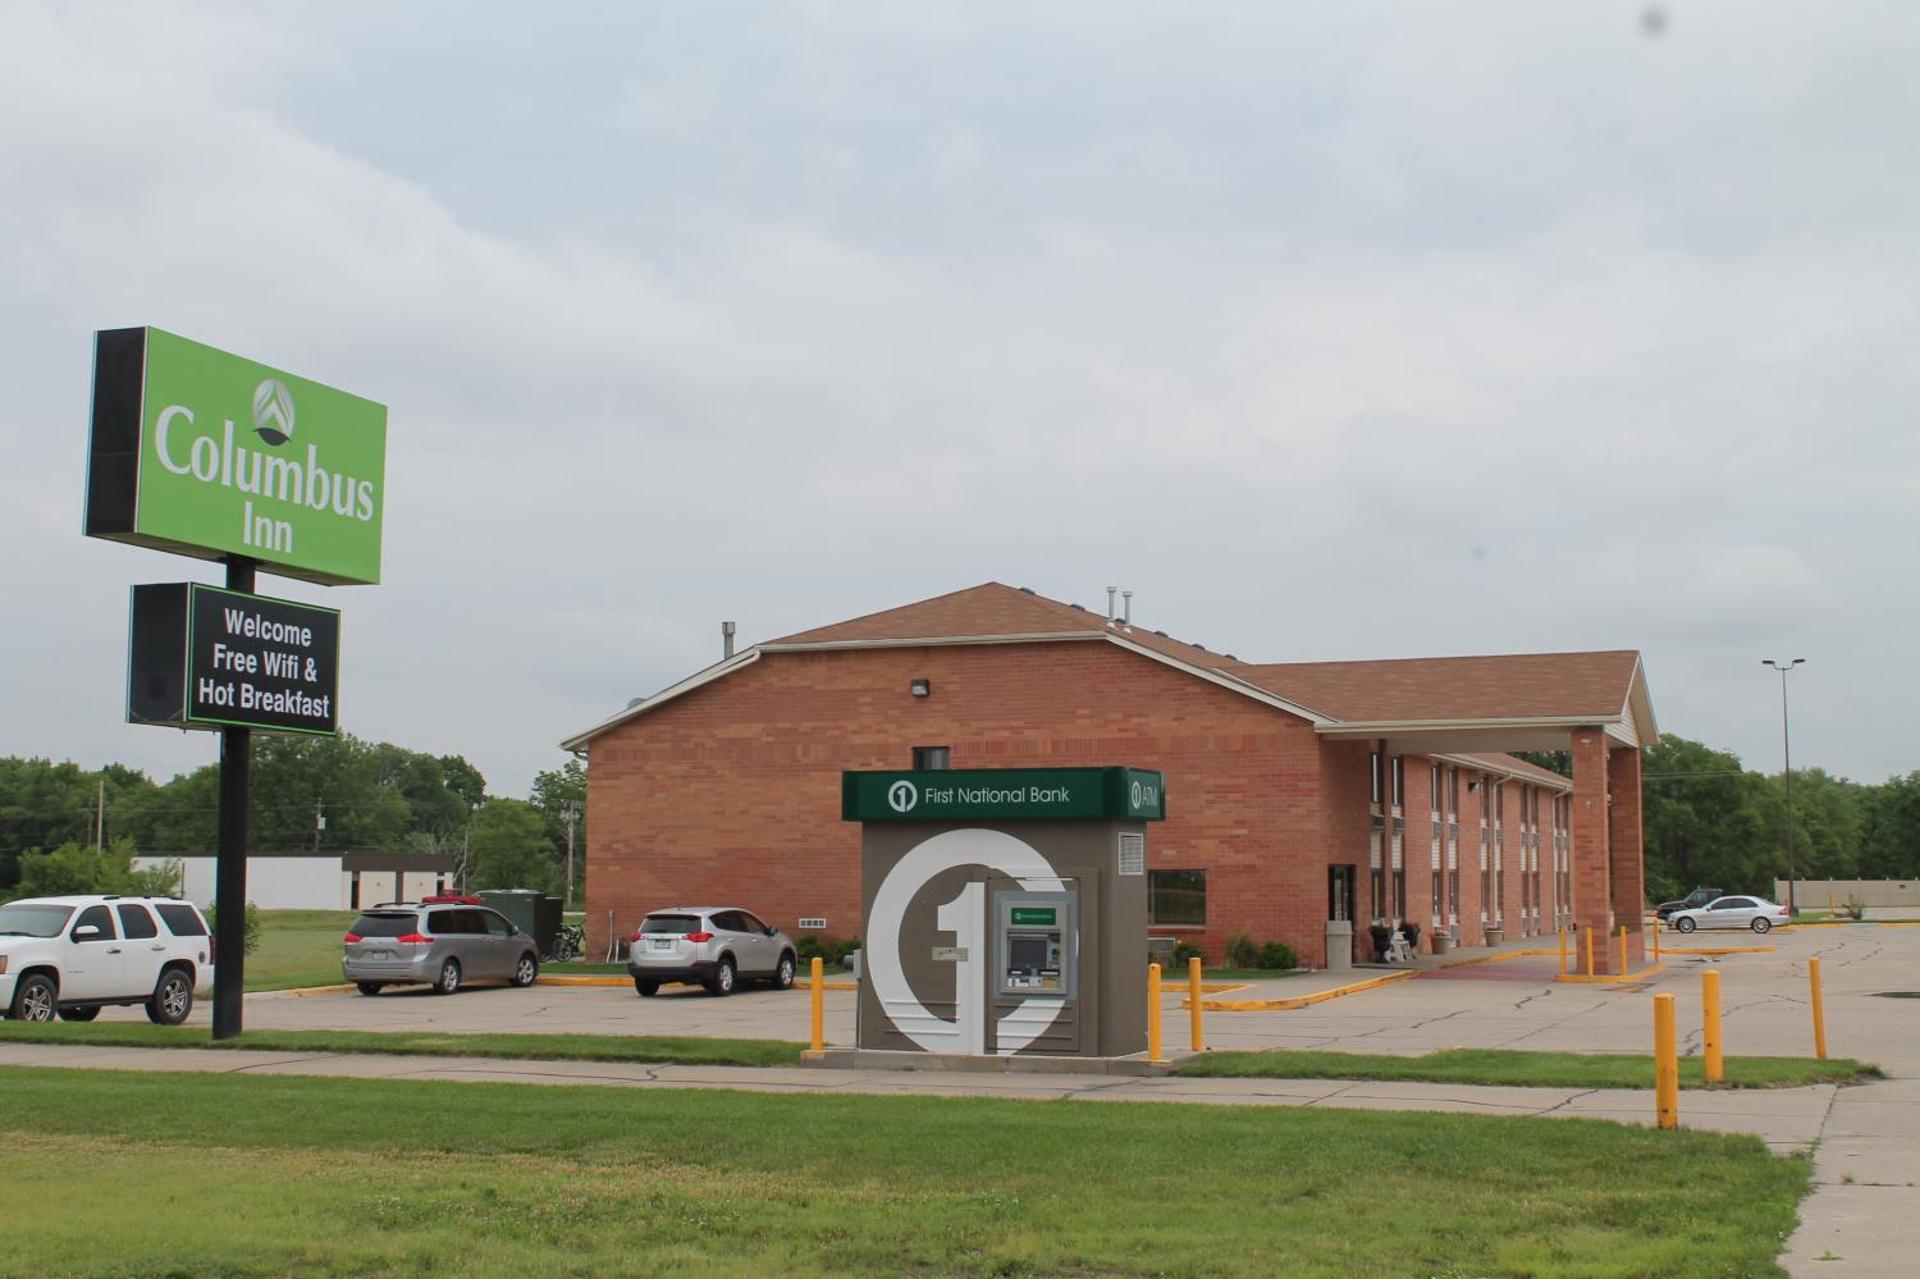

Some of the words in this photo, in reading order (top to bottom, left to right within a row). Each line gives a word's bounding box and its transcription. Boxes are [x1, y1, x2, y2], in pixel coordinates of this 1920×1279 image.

[154, 404, 374, 522] Columbus
[243, 501, 293, 554] Inn
[224, 607, 312, 648] Welcome
[213, 642, 258, 674] Free
[263, 650, 299, 680] Wifi
[304, 657, 318, 683] &
[199, 677, 235, 707] Hot
[240, 683, 330, 718] Breakfast
[925, 788, 954, 804] First
[957, 787, 1025, 804] National
[1030, 786, 1070, 803] Bank
